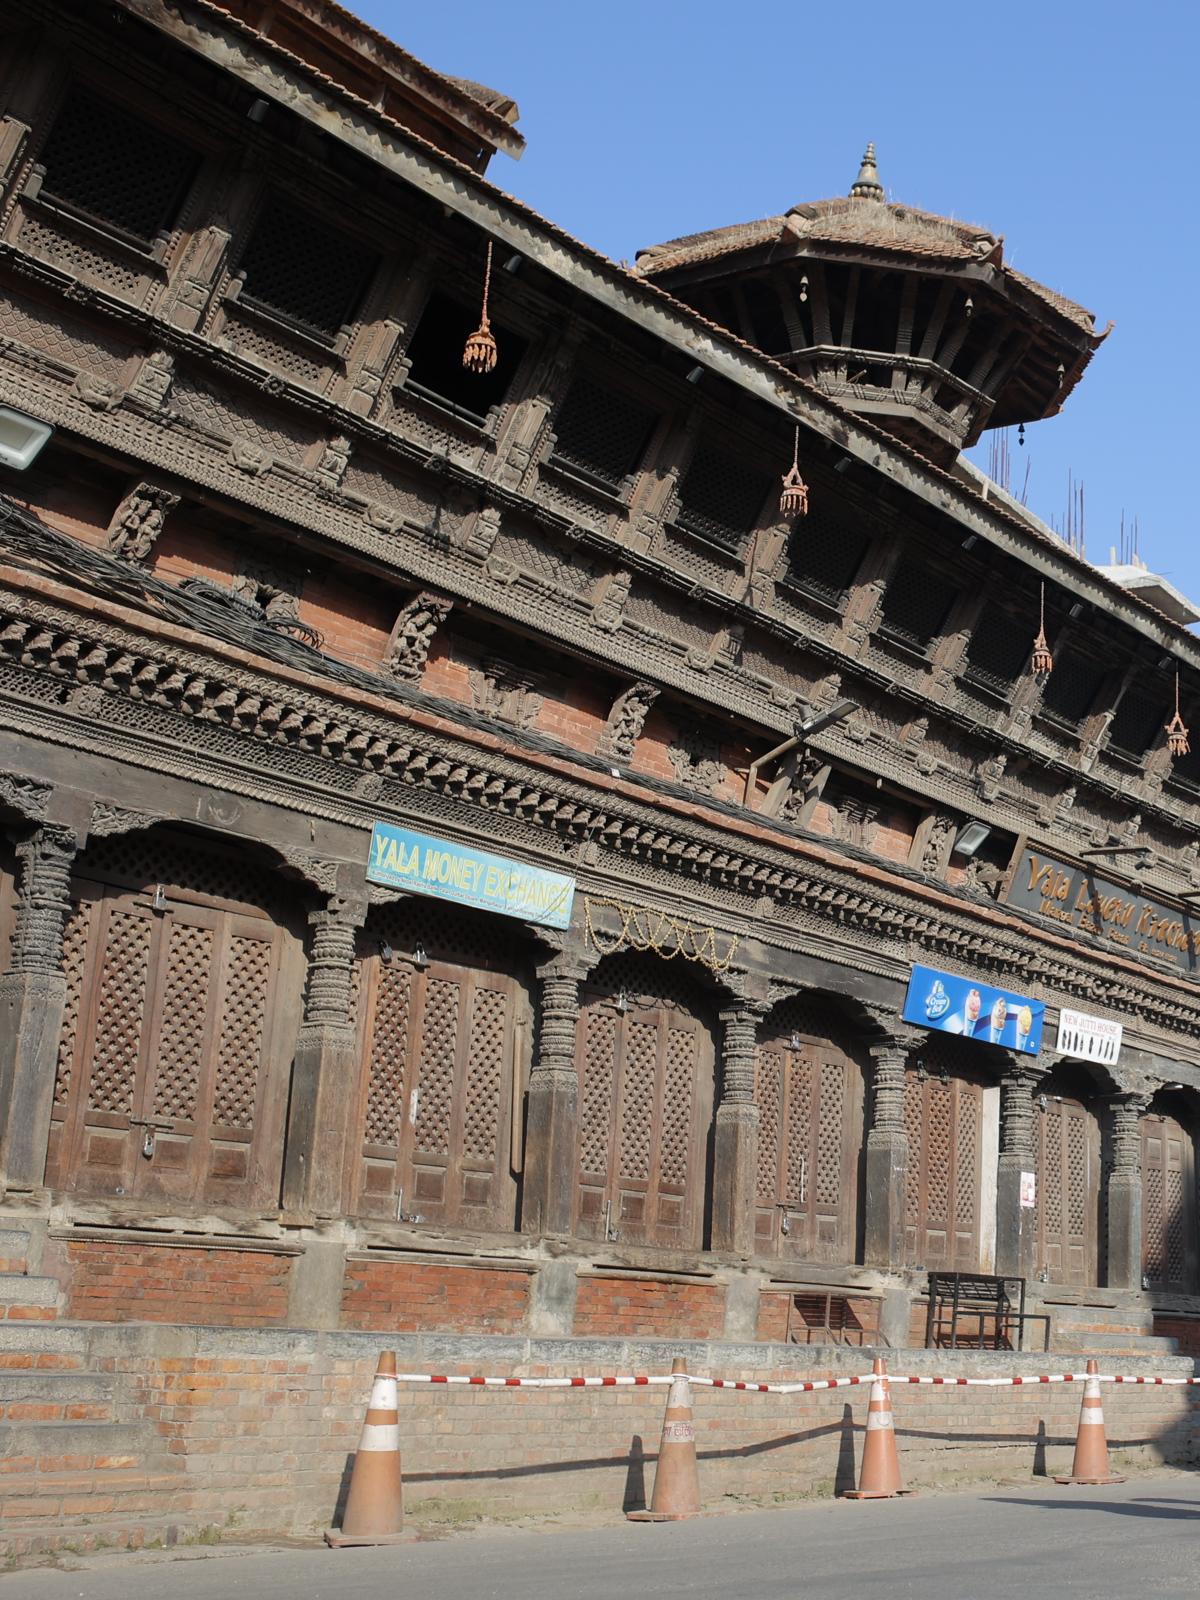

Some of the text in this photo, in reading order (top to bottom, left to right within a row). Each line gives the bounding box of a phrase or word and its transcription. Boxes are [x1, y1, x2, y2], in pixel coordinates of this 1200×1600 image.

[376, 834, 419, 877] YALA
[423, 848, 484, 892] MONEY
[1028, 855, 1071, 901] Yala
